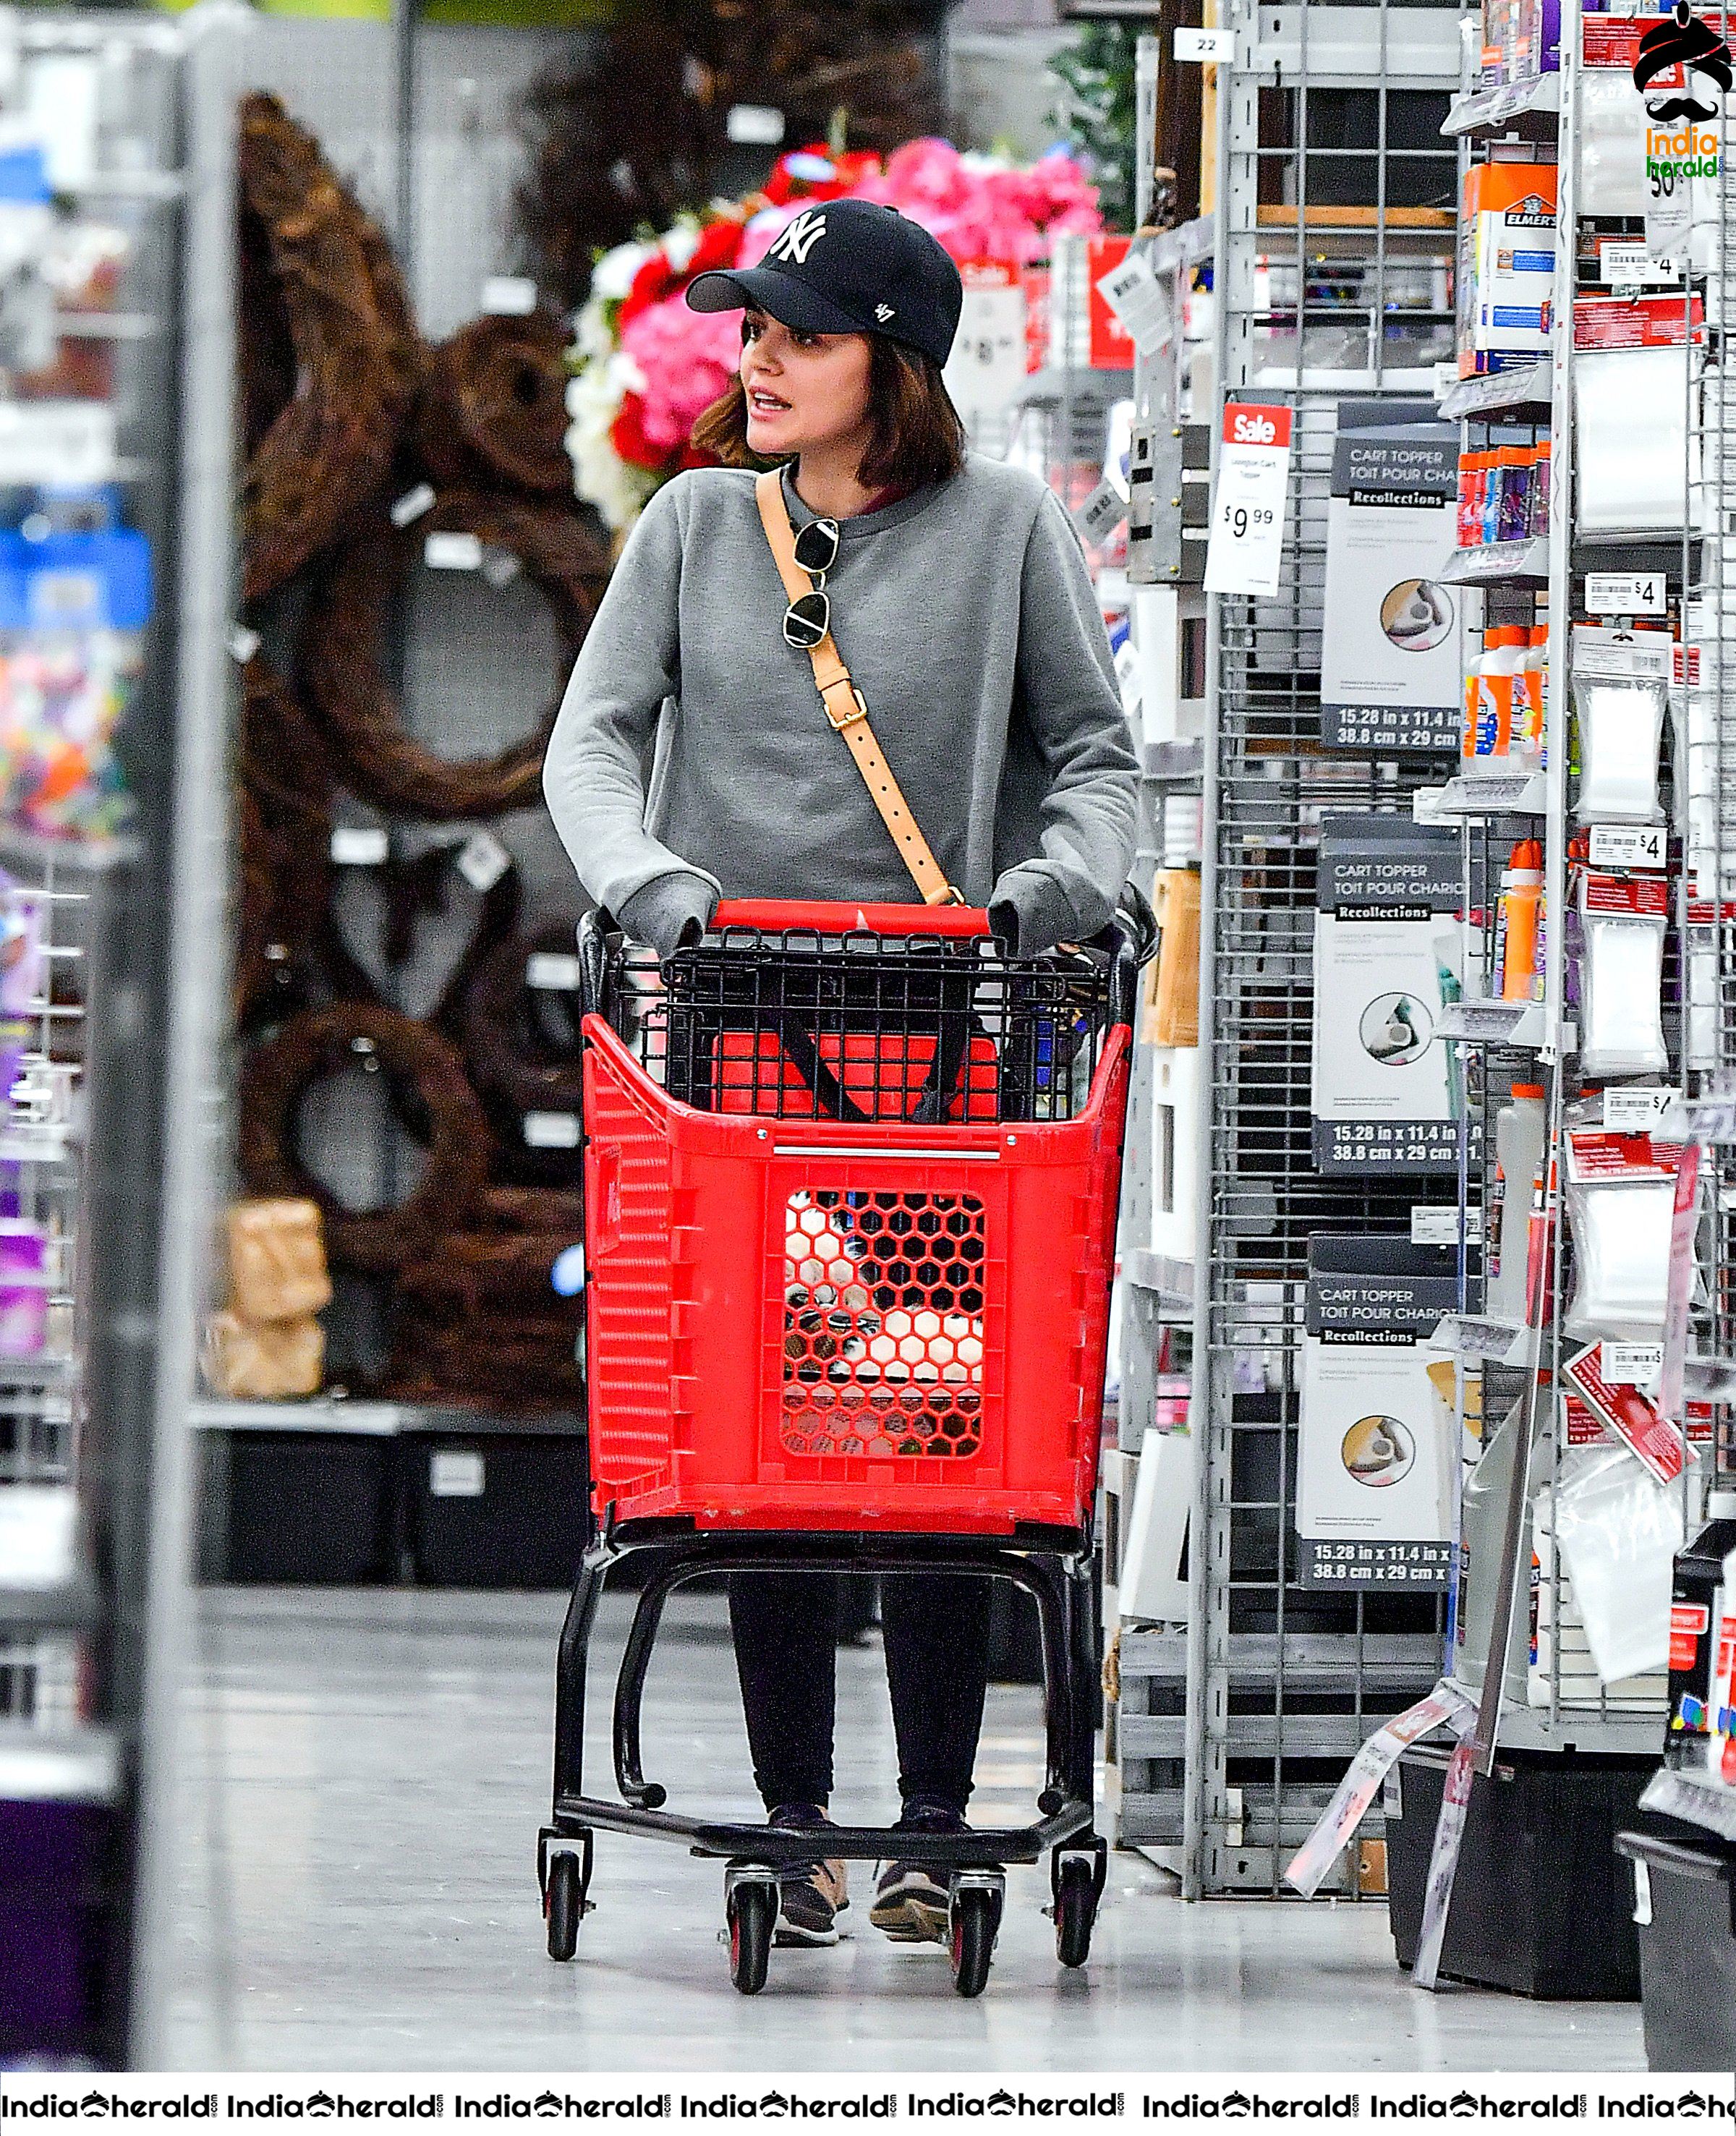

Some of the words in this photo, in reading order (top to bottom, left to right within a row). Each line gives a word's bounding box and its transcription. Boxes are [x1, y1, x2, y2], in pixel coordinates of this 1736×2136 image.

[1198, 39, 1216, 50] 22
[1234, 414, 1276, 443] Sale
[1350, 449, 1387, 462] CART
[1392, 450, 1444, 464] TOPPER
[1350, 467, 1378, 479] TOIT
[1382, 467, 1421, 480] POUR
[1353, 491, 1442, 505] Recollections
[1635, 582, 1654, 605] $4
[1338, 709, 1379, 725] 15.28
[1383, 710, 1397, 725] in
[1400, 713, 1410, 726] x
[1413, 710, 1443, 726] 11.4
[1447, 712, 1460, 727] in
[1337, 728, 1370, 744] 38.8
[1374, 731, 1396, 744] cm
[1399, 733, 1409, 745] x
[1410, 730, 1431, 746] 29
[1433, 733, 1457, 746] cm
[1640, 835, 1659, 859] $4
[1335, 865, 1372, 877] CART
[1375, 865, 1427, 877] TOPPER
[1335, 882, 1362, 894] TOIT
[1366, 882, 1405, 895] POUR
[1340, 905, 1428, 919] Recollections
[1333, 1126, 1374, 1141] 15.28
[1377, 1126, 1392, 1141] in
[1395, 1128, 1404, 1141] x
[1408, 1126, 1439, 1141] 11.4
[1442, 1126, 1456, 1141] in
[1333, 1145, 1366, 1160] 38.8
[1369, 1148, 1392, 1160] cm
[1395, 1148, 1404, 1160] x
[1407, 1145, 1426, 1160] 29
[1429, 1148, 1452, 1160] cm
[1319, 1290, 1356, 1301] CART
[1361, 1290, 1413, 1303] TOPPER
[1320, 1306, 1348, 1319] TOIT
[1351, 1307, 1390, 1319] POUR
[1324, 1330, 1413, 1343] Recollections
[1314, 1544, 1355, 1560] 15.28
[1358, 1545, 1373, 1560] in
[1375, 1548, 1385, 1560] x
[1388, 1546, 1419, 1561] 11.4
[1423, 1546, 1437, 1561] in
[1440, 1550, 1450, 1561] x
[1313, 1564, 1346, 1578] 38.8
[1350, 1567, 1371, 1579] cm
[1374, 1567, 1384, 1579] x
[1387, 1565, 1407, 1580] 29
[1410, 1568, 1432, 1580] cm
[1436, 1568, 1445, 1580] x
